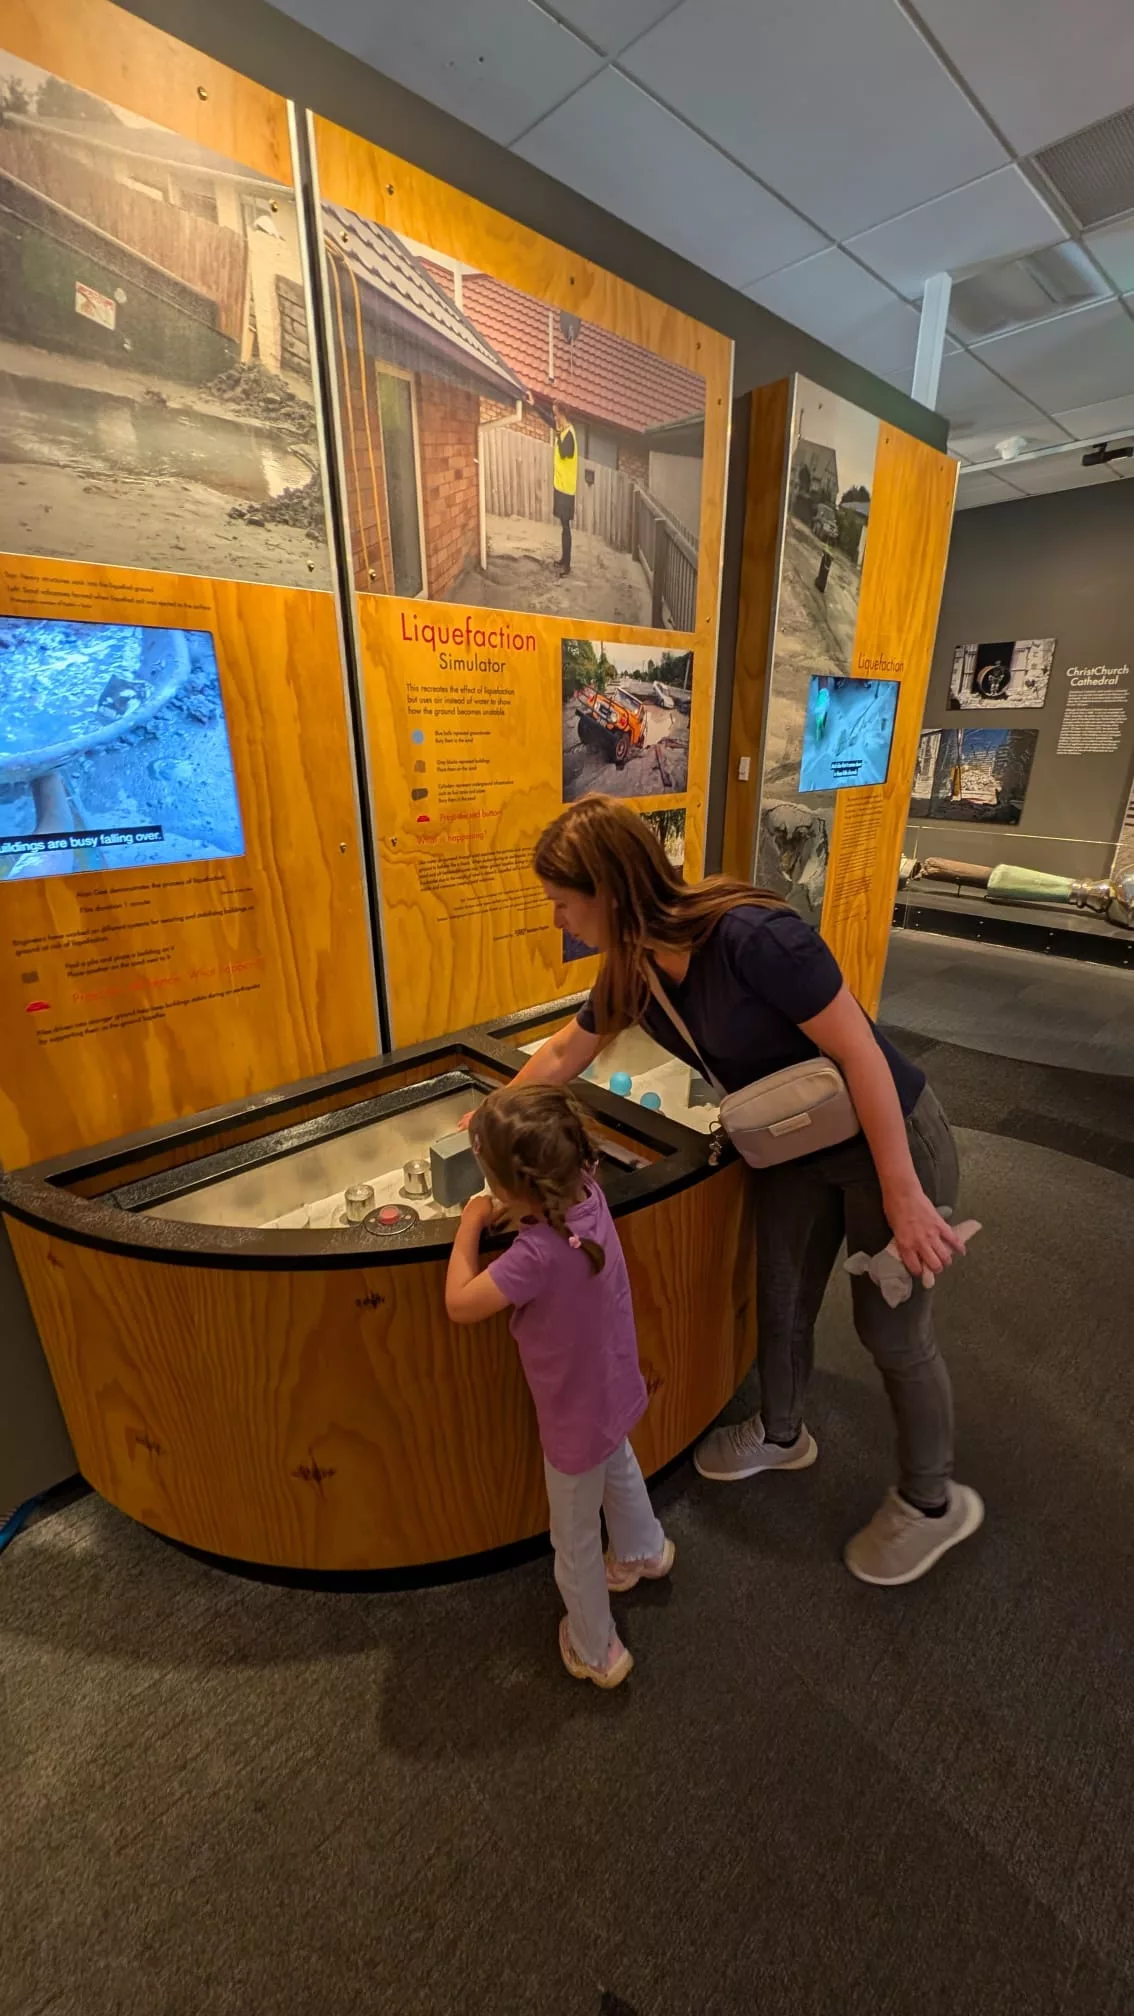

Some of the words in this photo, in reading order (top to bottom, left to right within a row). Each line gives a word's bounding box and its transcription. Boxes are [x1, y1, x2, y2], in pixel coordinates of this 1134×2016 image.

[401, 612, 536, 652] Liquefaction
[439, 652, 507, 673] Simulator
[1066, 664, 1130, 677] ChristChurch
[1070, 675, 1119, 687] Cathedral
[47, 839, 67, 850] are
[70, 835, 99, 848] busy
[100, 832, 133, 845] falling
[135, 832, 162, 842] over.
